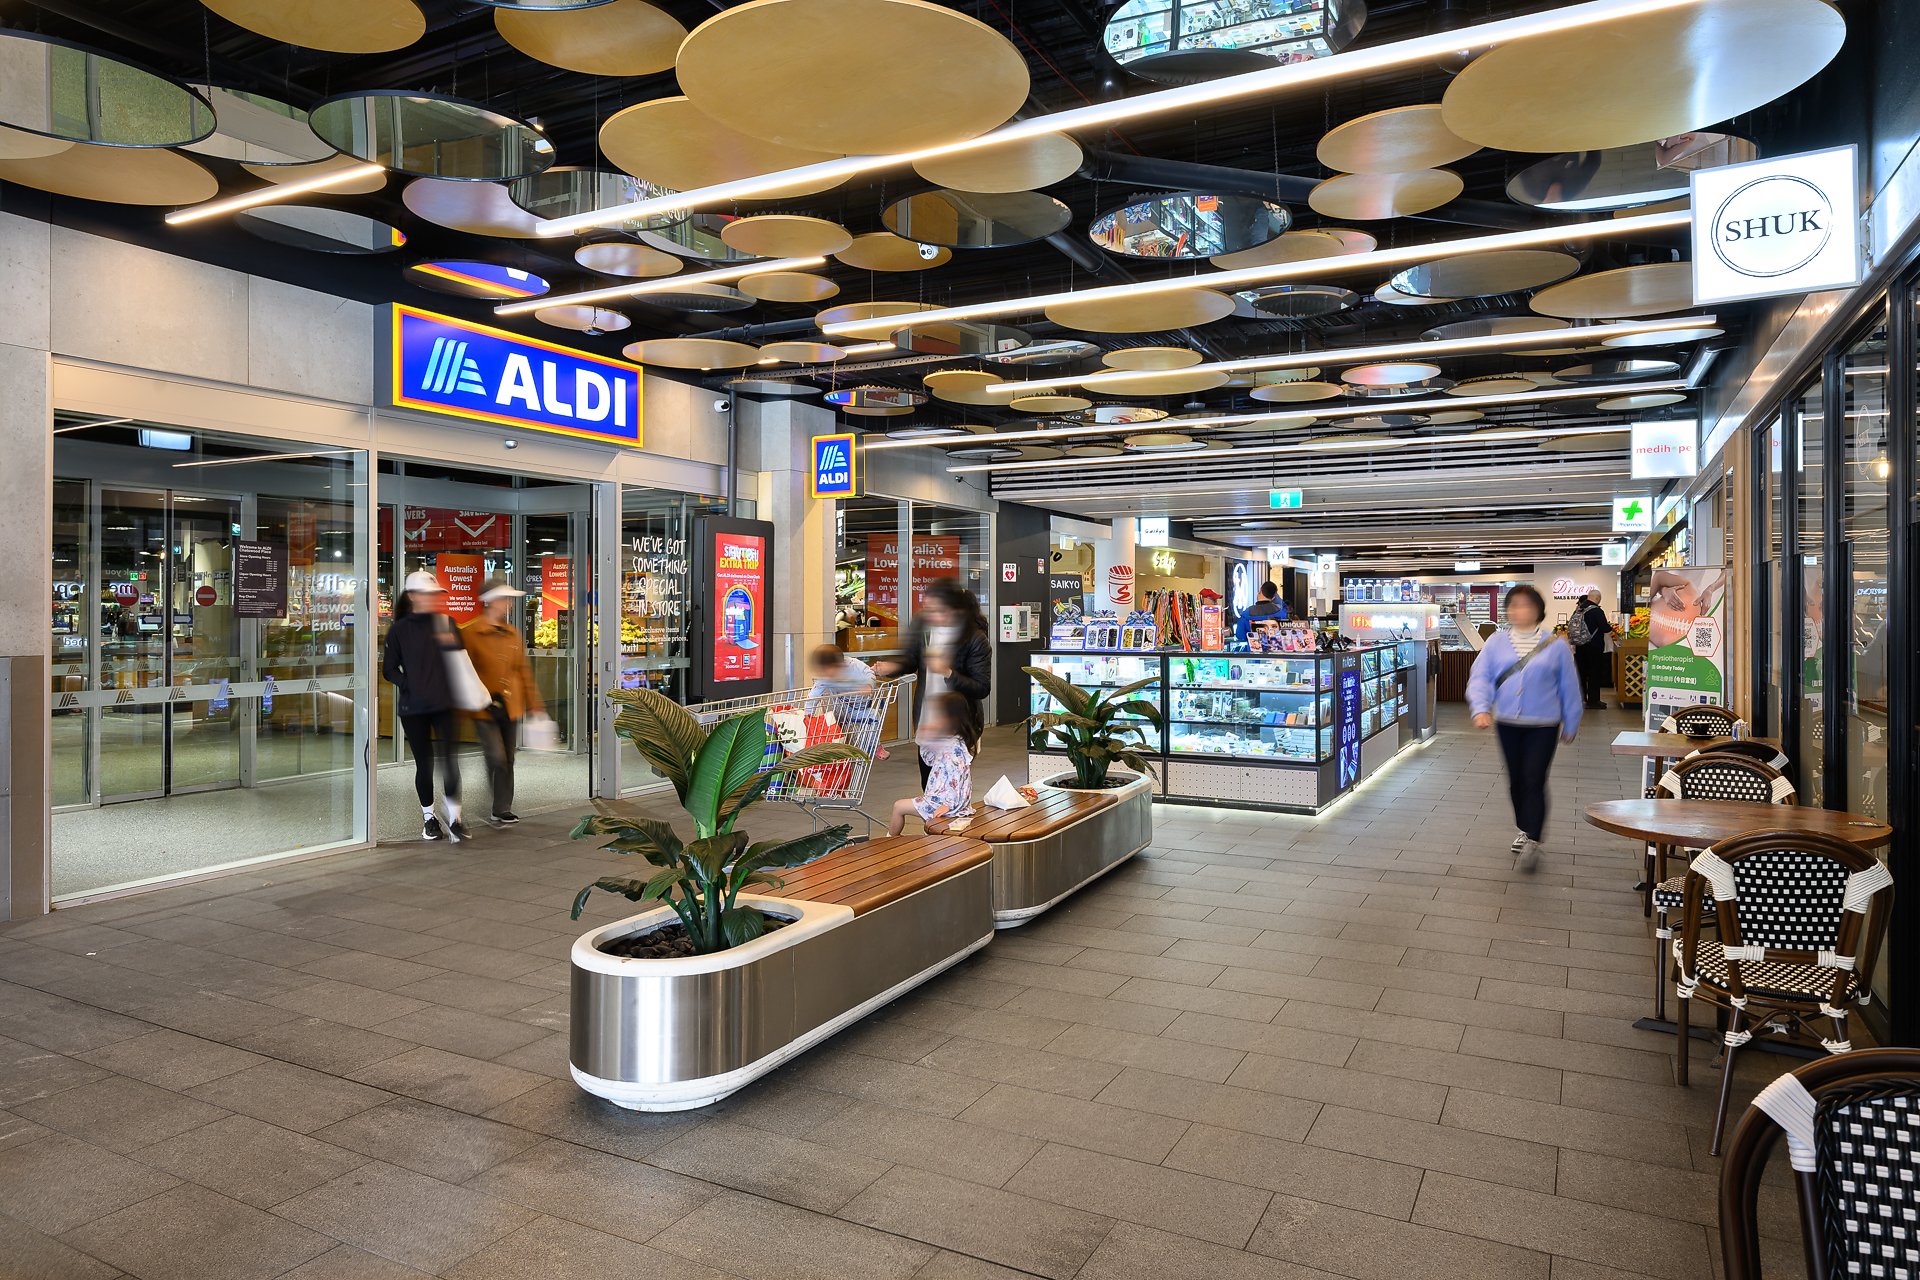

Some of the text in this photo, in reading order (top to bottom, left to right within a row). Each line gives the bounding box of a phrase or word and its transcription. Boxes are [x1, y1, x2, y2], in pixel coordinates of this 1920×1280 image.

[1725, 209, 1823, 242] SHUK
[496, 352, 627, 427] ALDI
[818, 472, 848, 484] ALDI
[632, 536, 686, 555] WE'VE GOT
[444, 566, 478, 574] Australia's
[632, 556, 688, 574] SOMETHING
[720, 557, 759, 570] EXTRA TRIP
[918, 557, 952, 568] Prices
[638, 577, 682, 596] SPECIAL
[1050, 580, 1080, 588] SAIKYO
[638, 600, 682, 617] IN STORE
[1652, 654, 1694, 664] Physiotherapist
